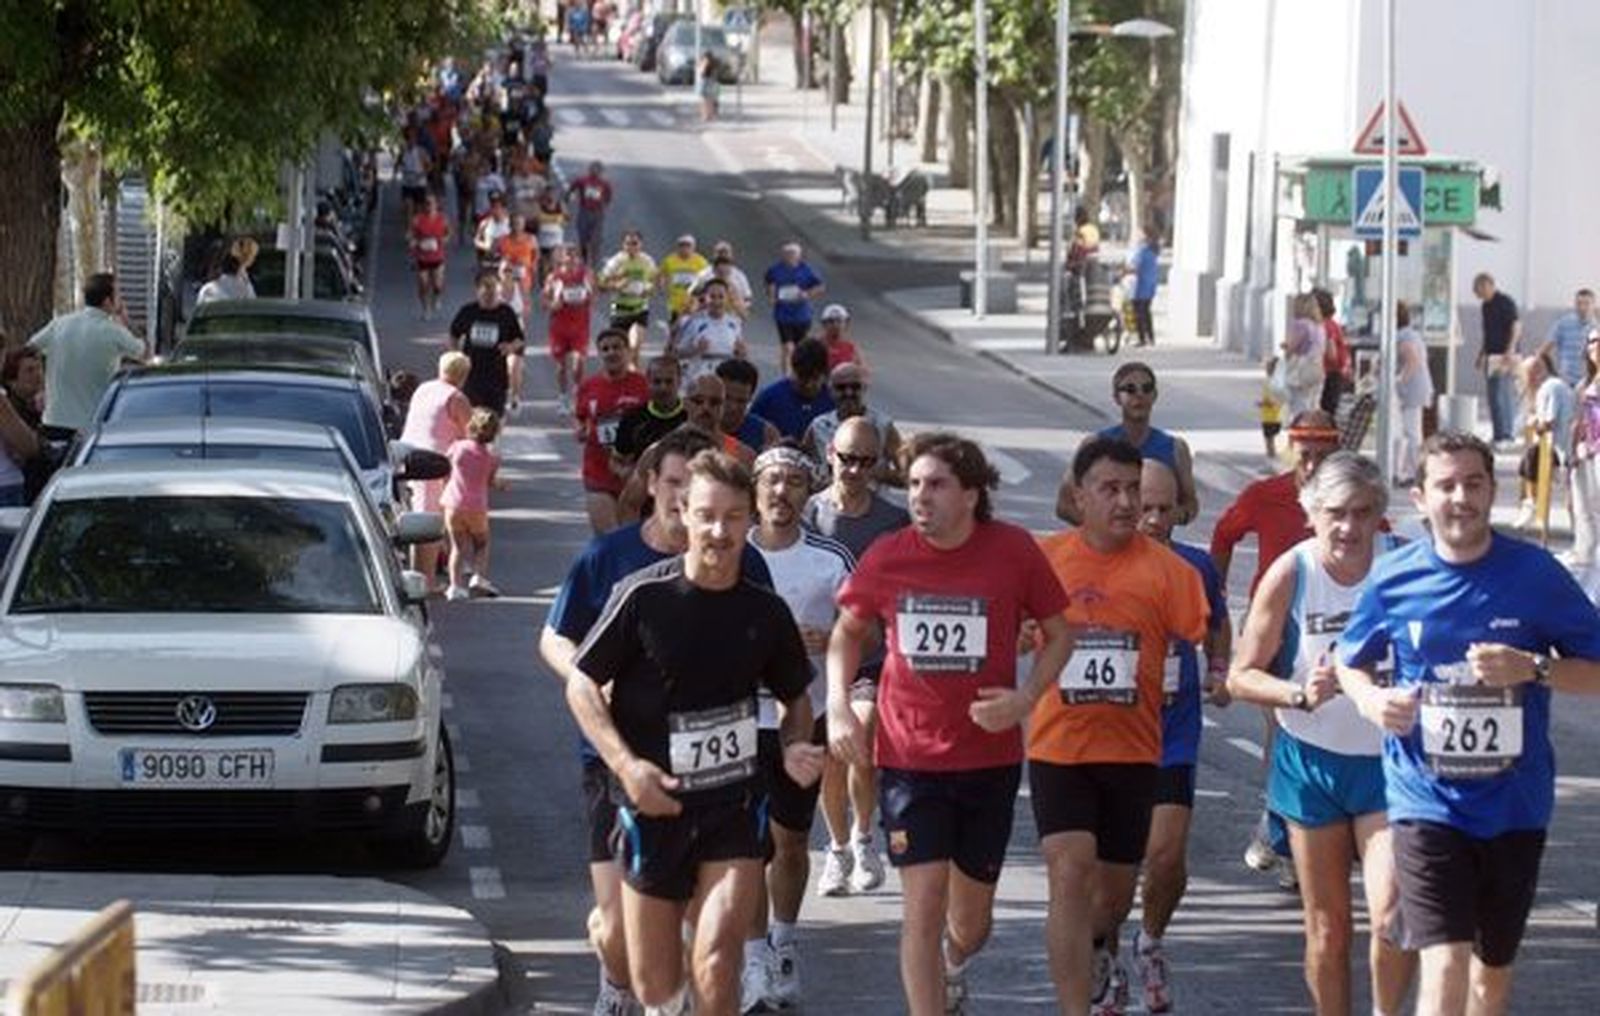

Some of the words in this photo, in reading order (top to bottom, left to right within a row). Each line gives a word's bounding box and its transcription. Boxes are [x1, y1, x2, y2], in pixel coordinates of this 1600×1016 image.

[1424, 188, 1460, 212] CE
[915, 622, 967, 652] 292
[1084, 657, 1116, 686] 46
[1442, 717, 1500, 751] 262
[690, 730, 740, 769] 793
[142, 755, 206, 779] 9090
[217, 755, 267, 779] CFH
